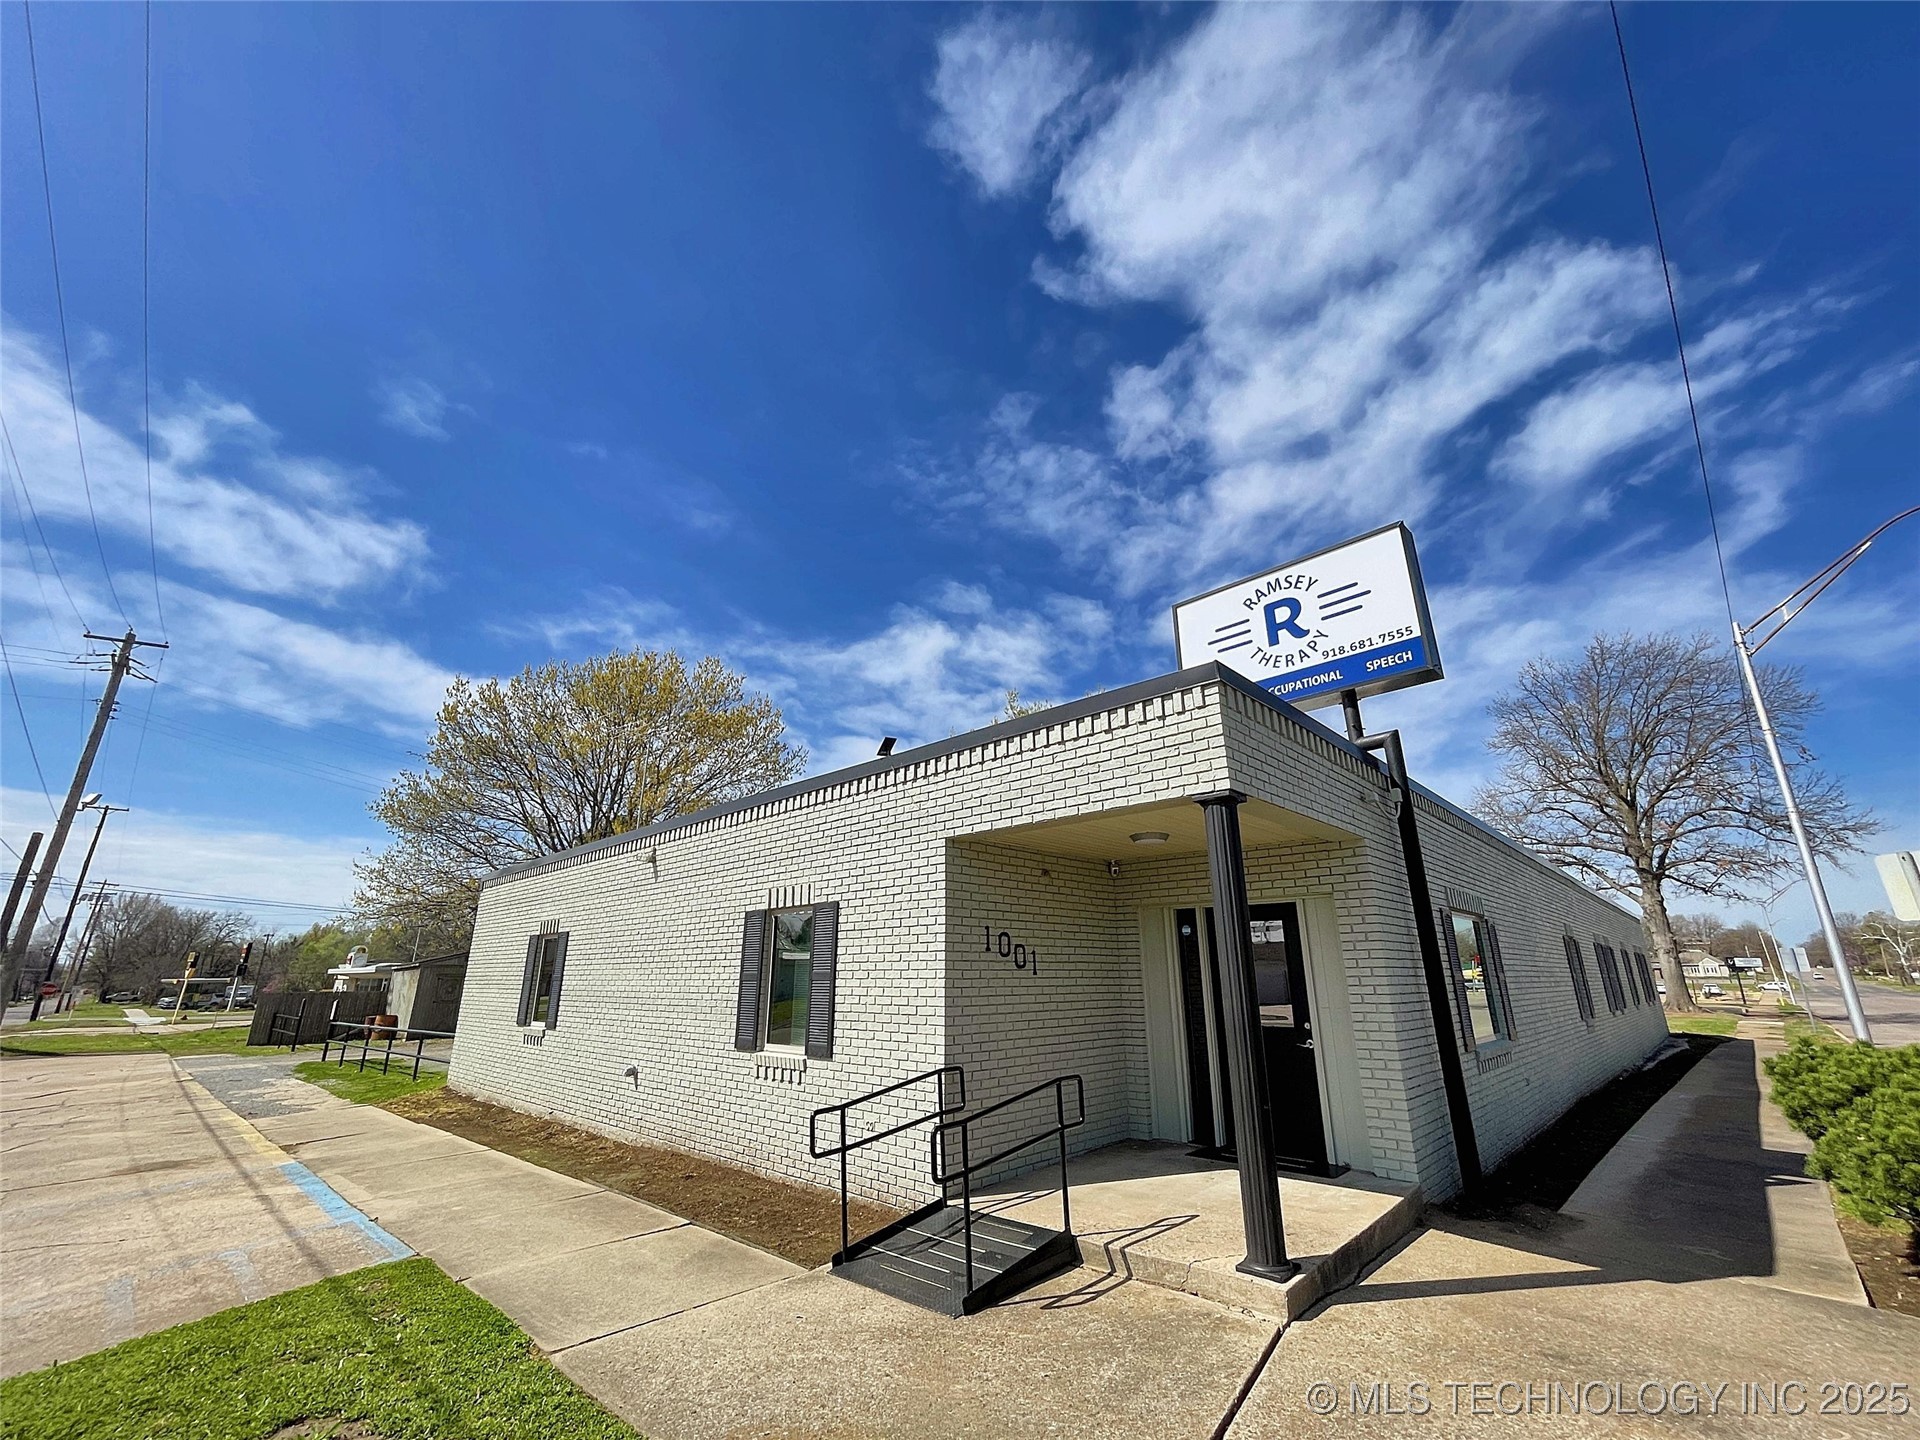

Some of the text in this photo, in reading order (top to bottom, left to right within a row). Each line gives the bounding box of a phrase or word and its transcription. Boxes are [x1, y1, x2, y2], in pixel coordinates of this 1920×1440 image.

[1243, 574, 1320, 612] RAMSEY
[1263, 597, 1311, 648] R
[1250, 629, 1329, 669] THERAPY
[1321, 625, 1414, 660] 918.681.7555
[1365, 650, 1413, 672] SPEECH
[985, 926, 1038, 975] 1001
